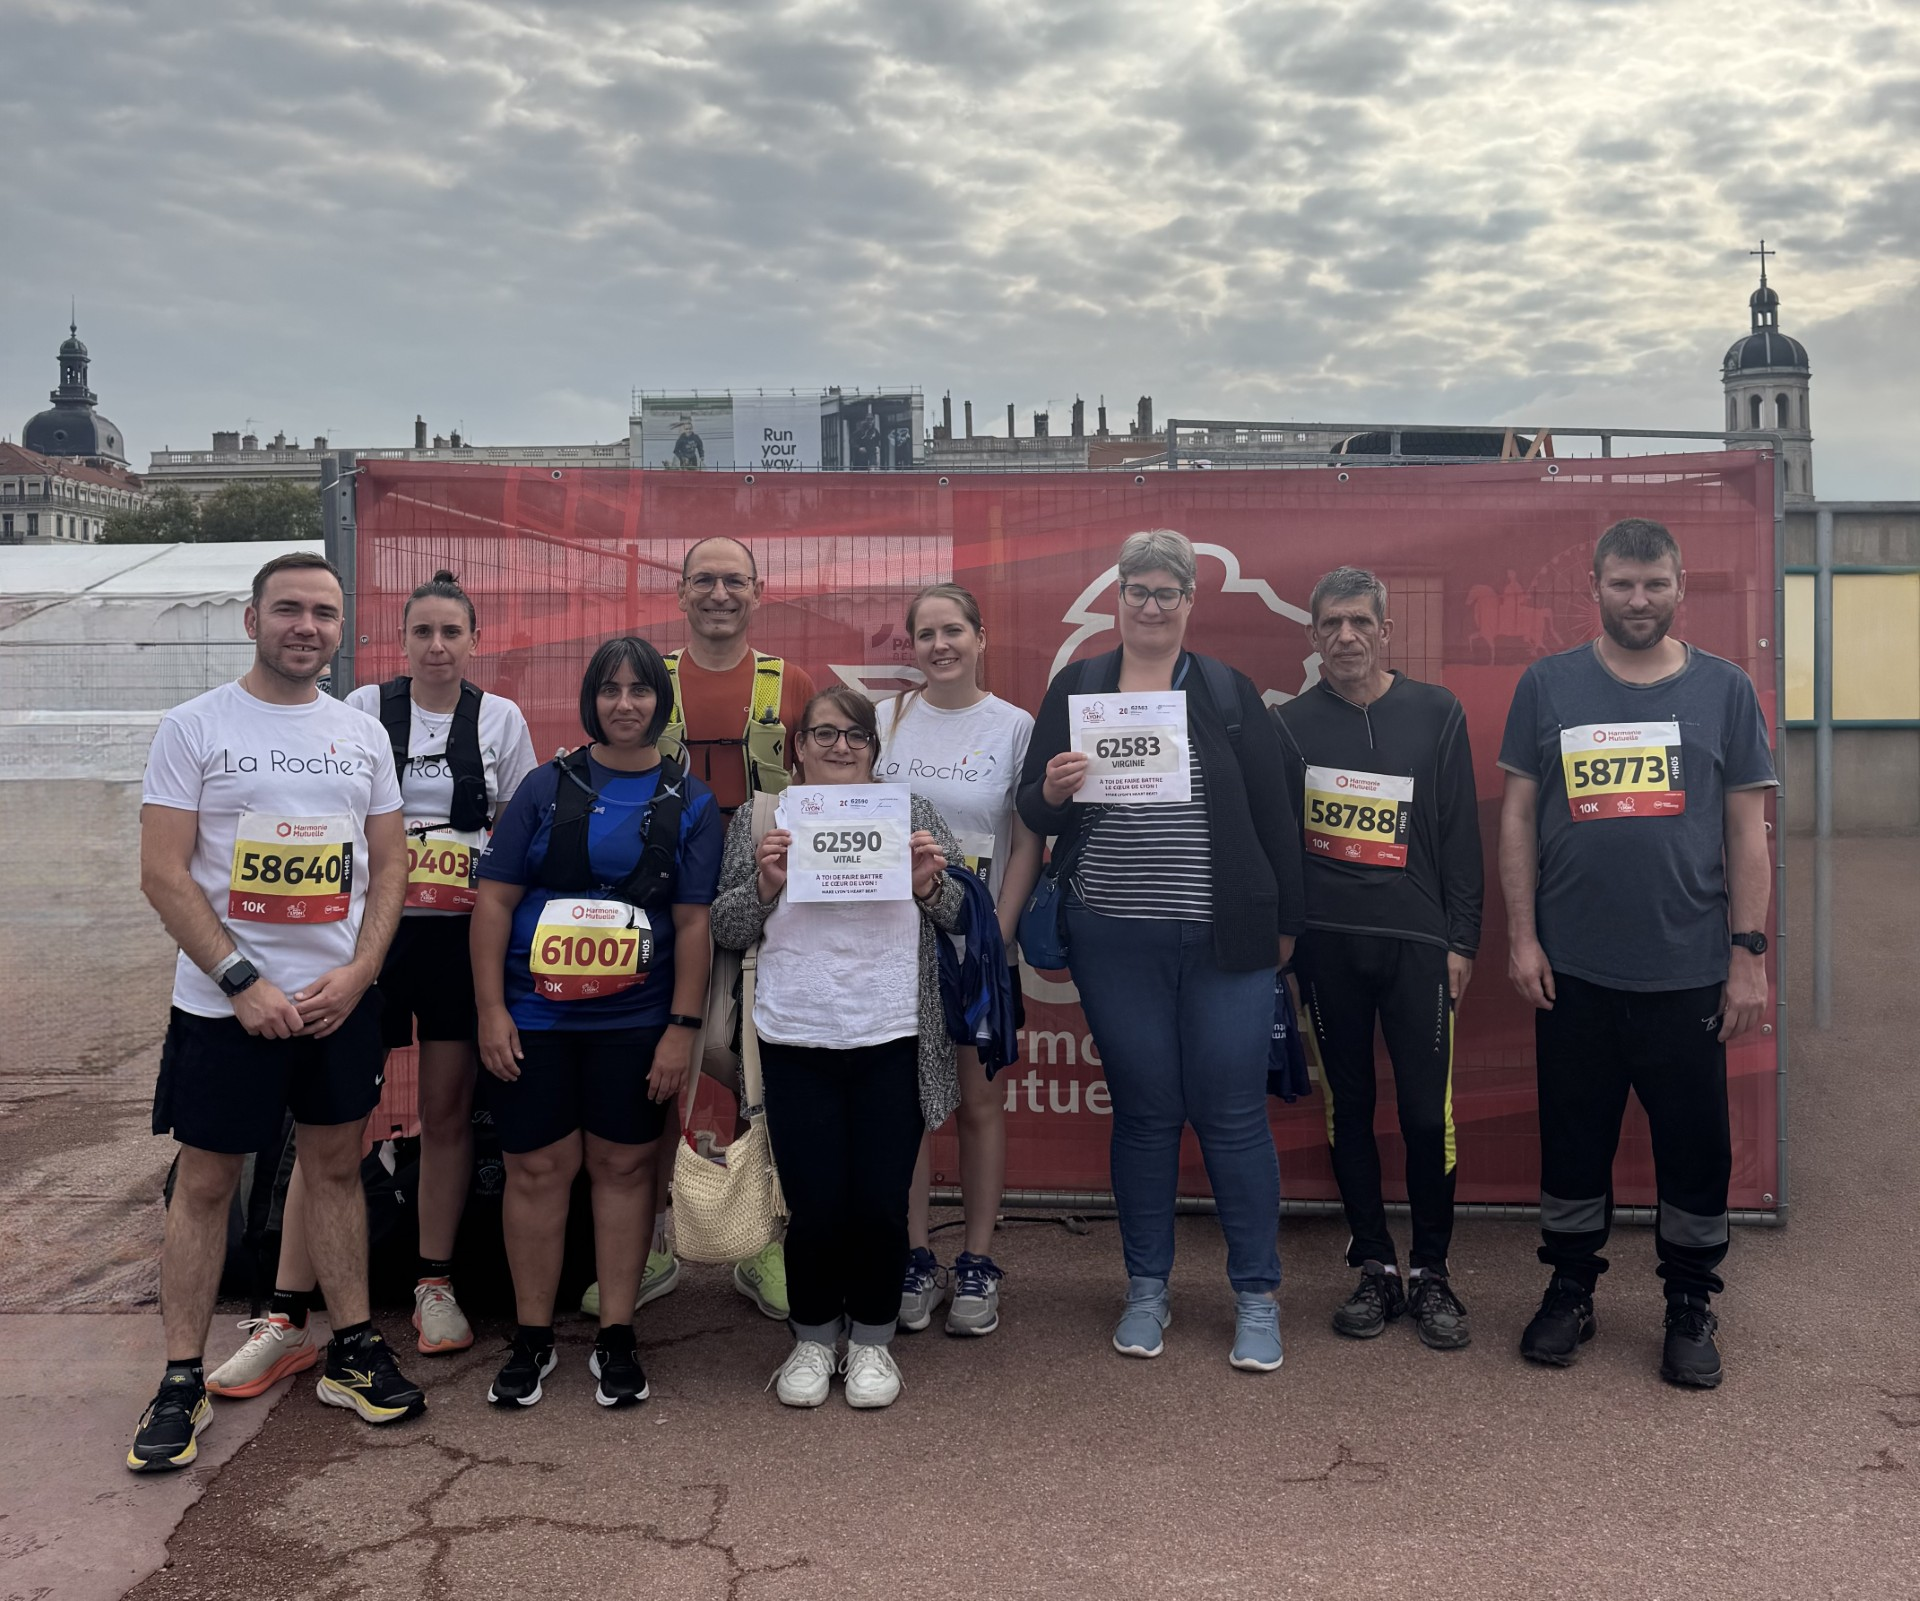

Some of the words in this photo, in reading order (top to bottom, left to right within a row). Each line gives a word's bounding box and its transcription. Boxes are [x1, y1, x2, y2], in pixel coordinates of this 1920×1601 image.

[763, 428, 793, 441] Run
[761, 444, 797, 458] your
[1096, 736, 1161, 759] 62583
[224, 749, 257, 773] La
[271, 750, 354, 775] Roche
[1112, 759, 1145, 768] VIRGINIE
[876, 758, 900, 777] La
[908, 758, 978, 782] Roche
[1574, 756, 1665, 788] 58773
[1349, 783, 1377, 791] Mutuelle
[1350, 778, 1380, 786] Harmonie
[1579, 802, 1599, 813] 10K
[1311, 799, 1395, 833] 58788
[813, 831, 882, 853] 62590
[1312, 838, 1330, 850] 10K
[407, 849, 469, 878] 0403
[833, 855, 861, 863] VITALE
[241, 853, 341, 884] 58640
[241, 900, 266, 913] 10K
[541, 935, 637, 967] 61007
[543, 980, 563, 992] 10K
